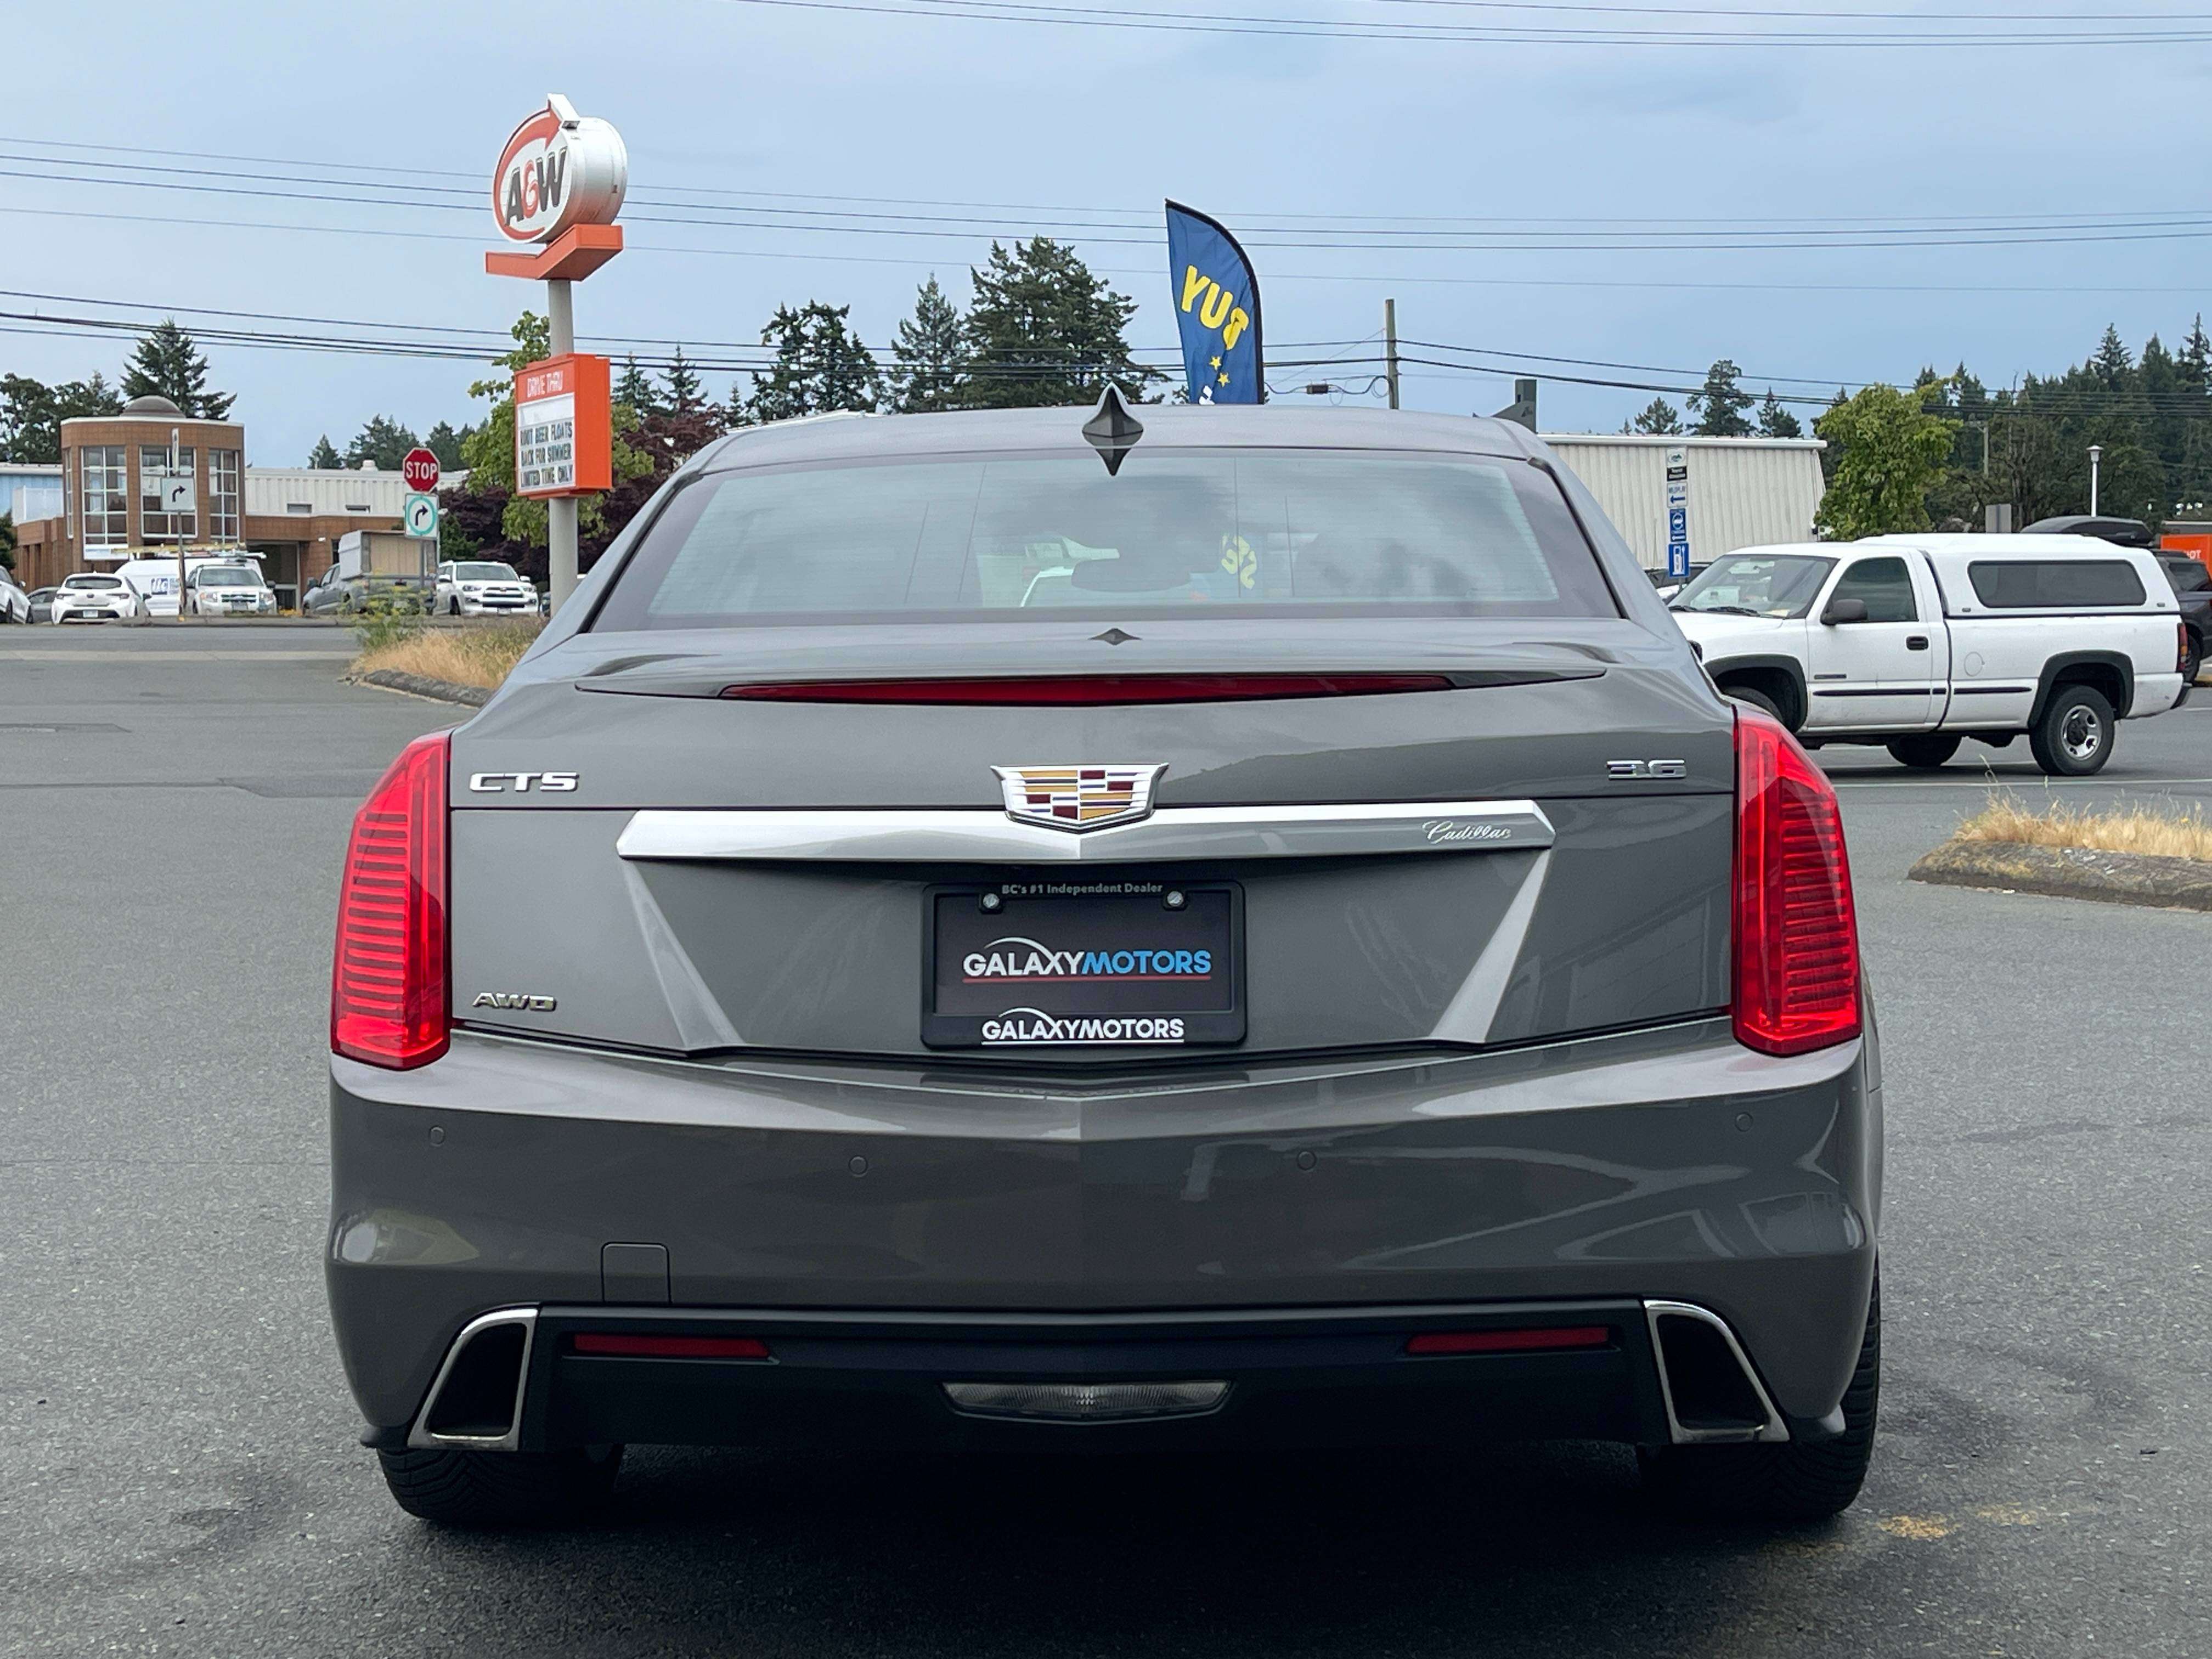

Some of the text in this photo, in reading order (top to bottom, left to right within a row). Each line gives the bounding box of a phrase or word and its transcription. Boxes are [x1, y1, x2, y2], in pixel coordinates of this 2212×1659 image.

[505, 146, 568, 226] A&W
[527, 375, 545, 398] DRIVE
[535, 425, 548, 443] BEER
[551, 421, 572, 440] FLOATS
[548, 443, 571, 462] SUMMER
[406, 461, 437, 480] STOP
[470, 772, 579, 792] CTS
[1422, 820, 1511, 844] Cadillac
[1002, 882, 1163, 896] BC's #1 Independent Dealer
[472, 992, 557, 1012] AWD
